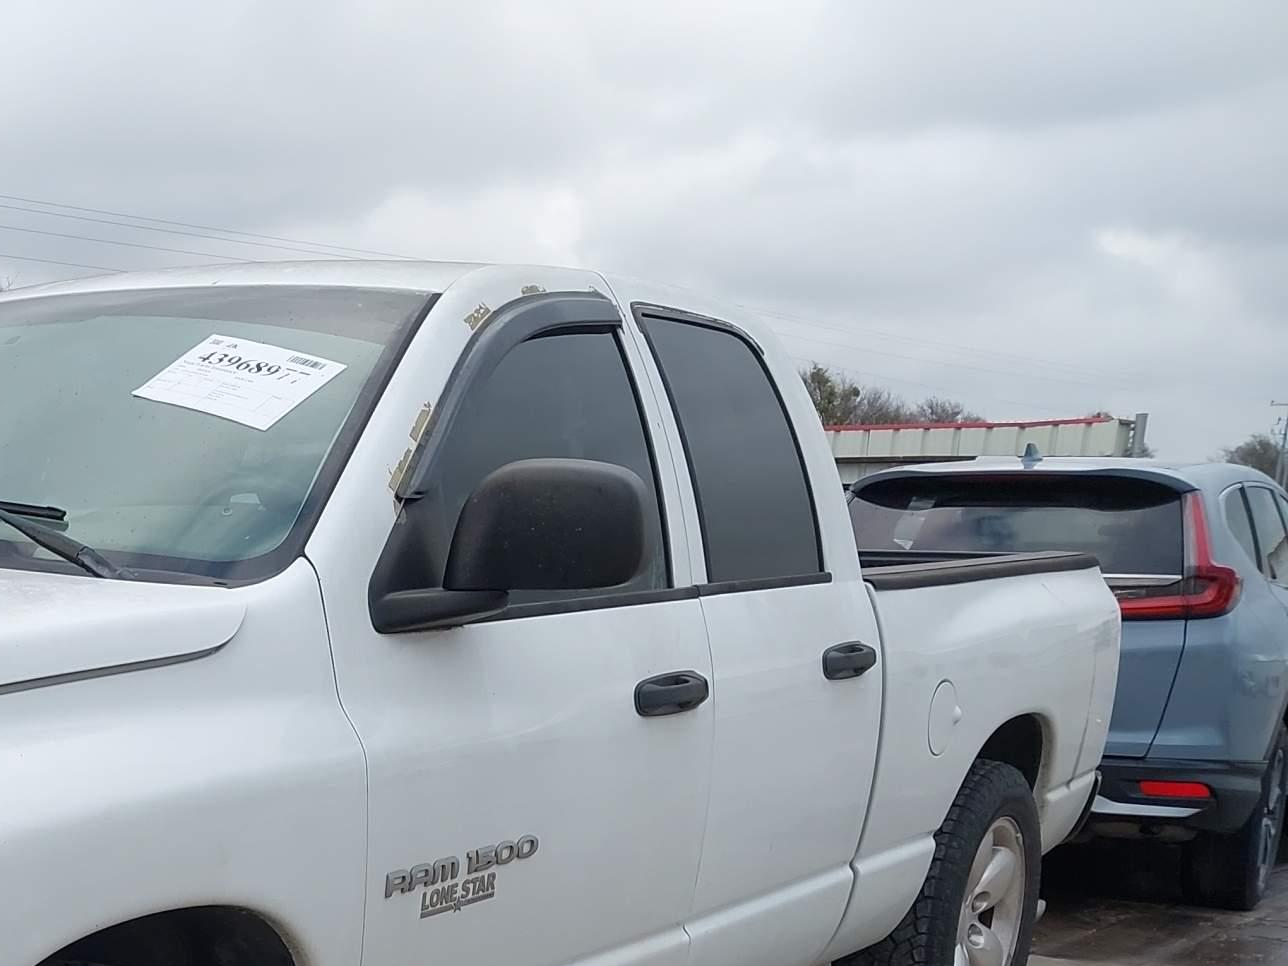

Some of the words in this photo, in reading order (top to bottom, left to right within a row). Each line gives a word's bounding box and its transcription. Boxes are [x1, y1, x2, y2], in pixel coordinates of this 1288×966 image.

[385, 856, 460, 898] RAM
[466, 834, 539, 874] 1500
[421, 882, 458, 911] LONE
[462, 872, 496, 899] STAR
